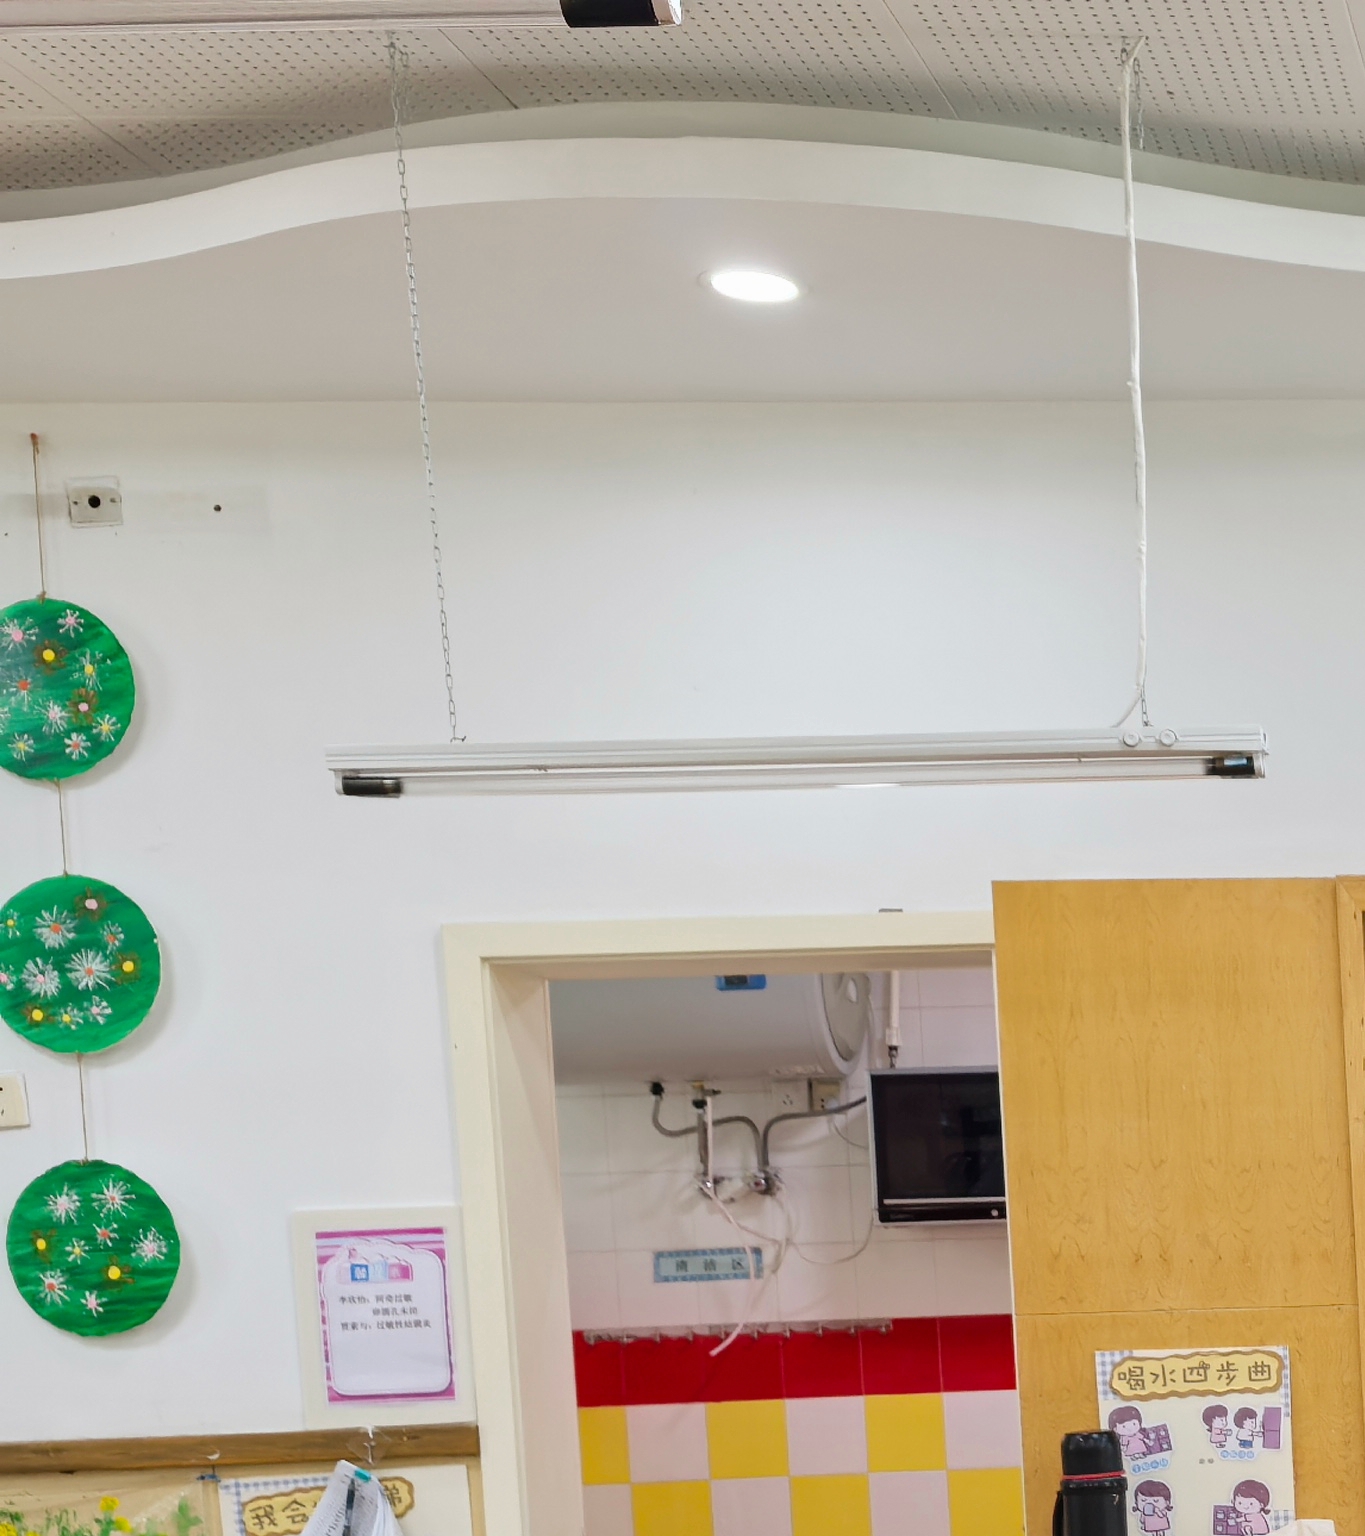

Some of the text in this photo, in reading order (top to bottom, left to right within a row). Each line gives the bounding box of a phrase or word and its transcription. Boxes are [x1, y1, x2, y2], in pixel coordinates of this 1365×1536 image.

[1117, 1360, 1272, 1391] 喝水四步曲
